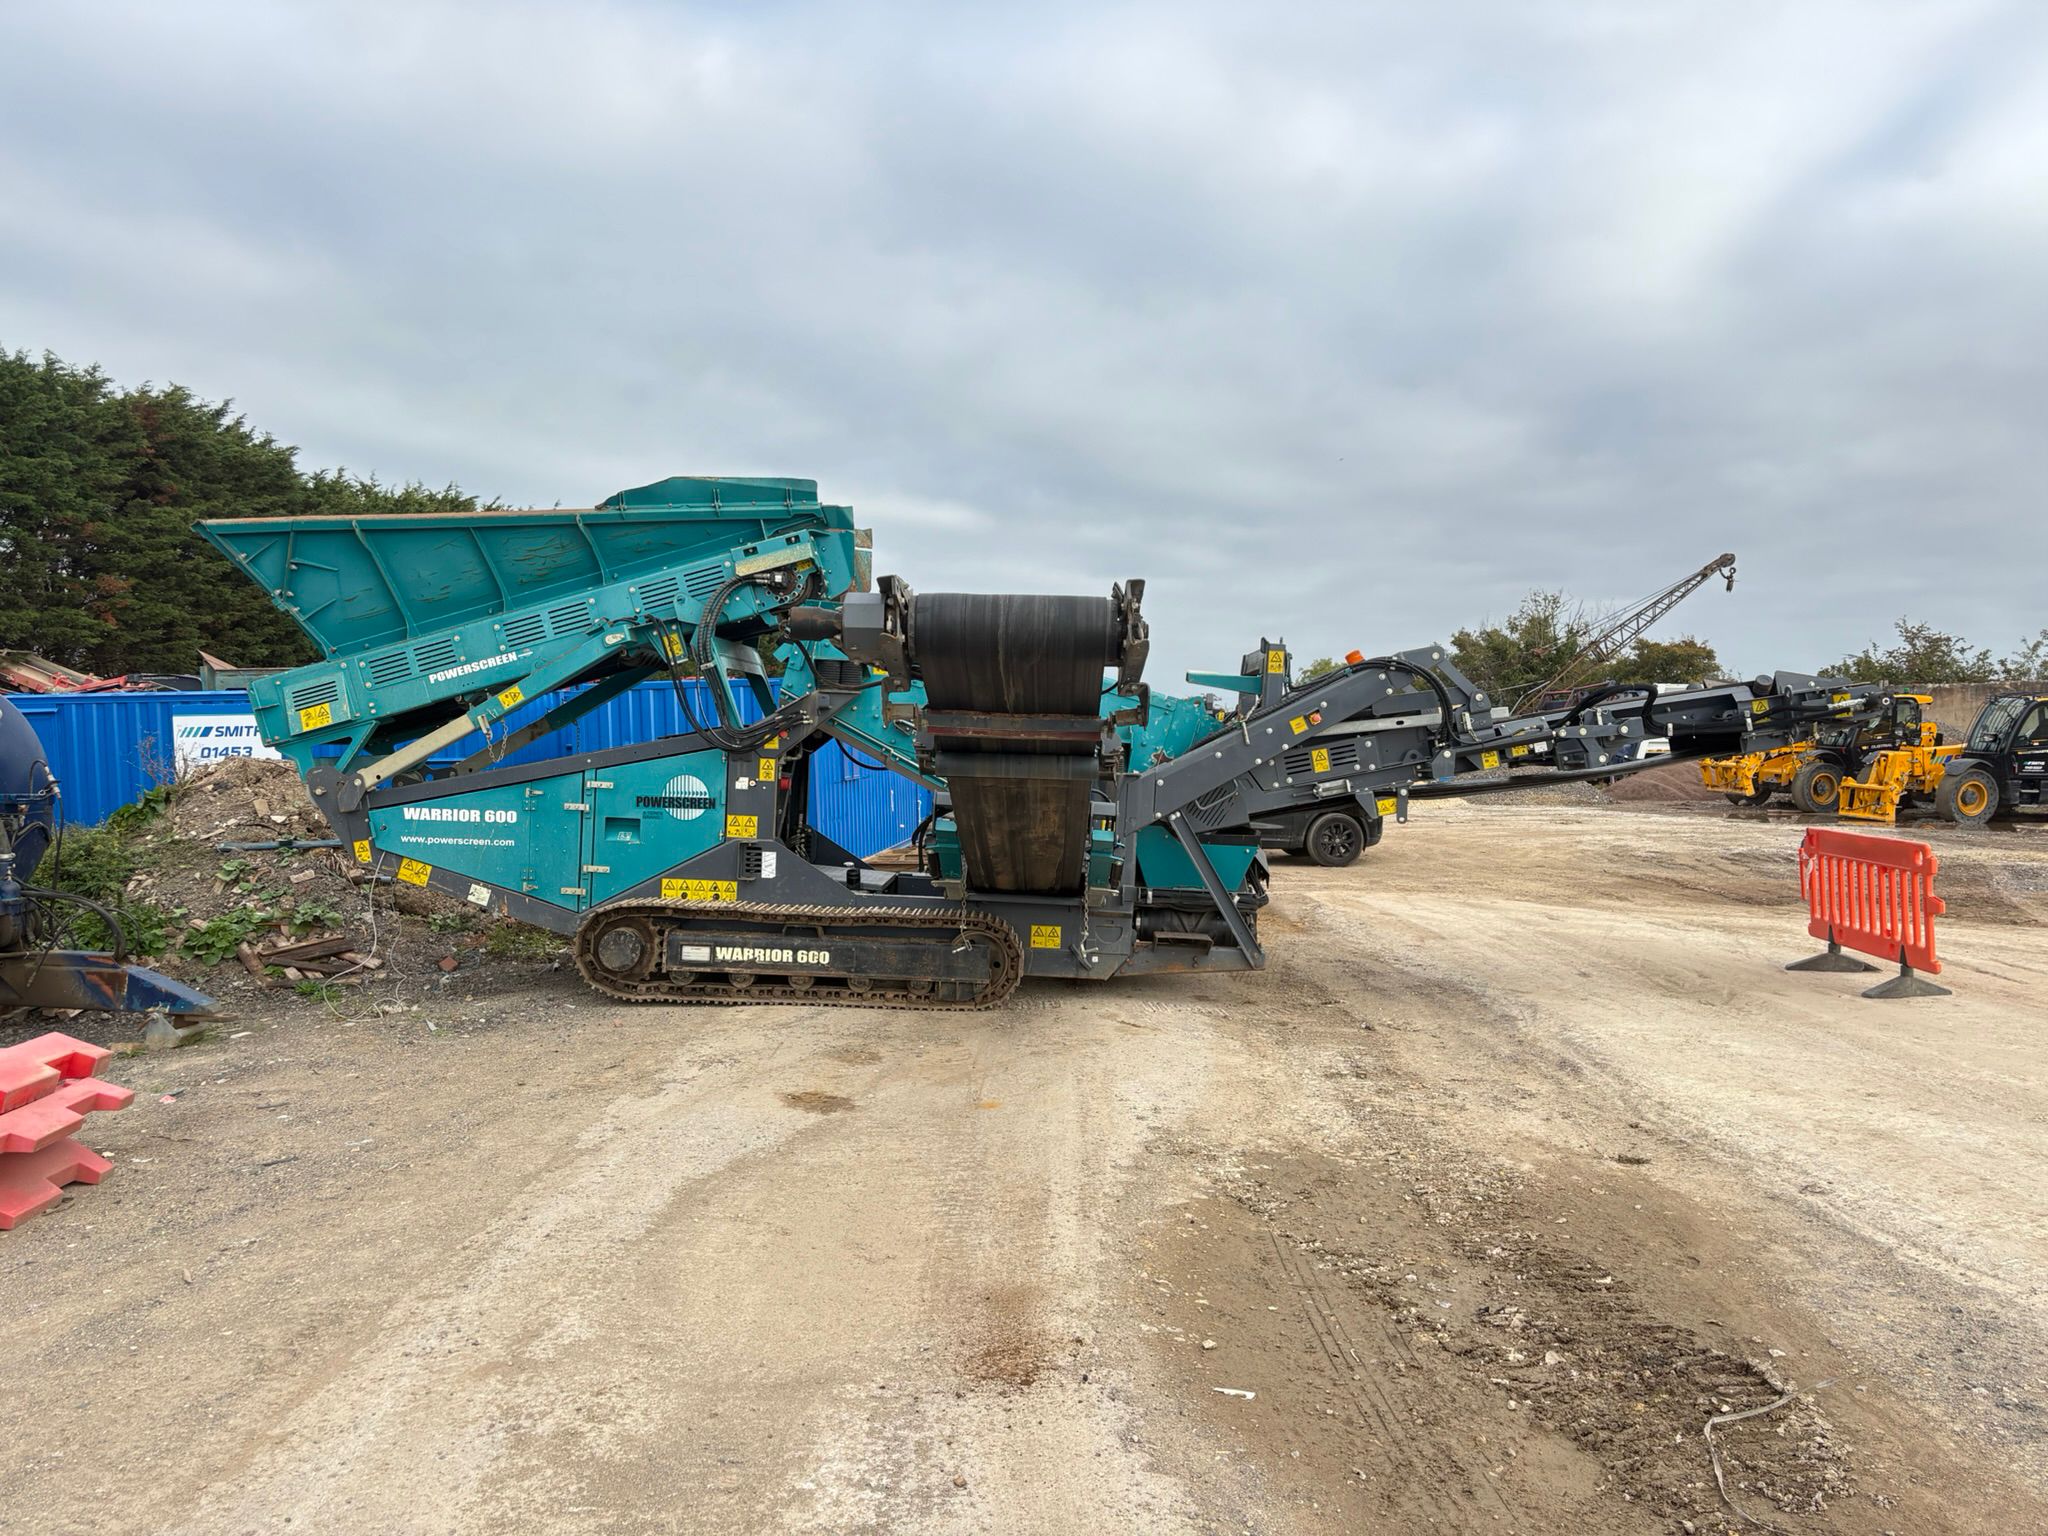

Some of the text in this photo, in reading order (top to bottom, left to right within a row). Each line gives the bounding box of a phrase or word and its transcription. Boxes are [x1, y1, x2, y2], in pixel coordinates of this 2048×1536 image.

[428, 651, 518, 684] POWERSCREEN
[200, 746, 253, 759] 01453
[636, 796, 716, 809] POWERSCREEN
[403, 807, 518, 824] WARRIOR 600
[400, 835, 516, 847] www.powerscreen.com
[715, 946, 793, 963] WARRIOR
[796, 950, 830, 965] 600
